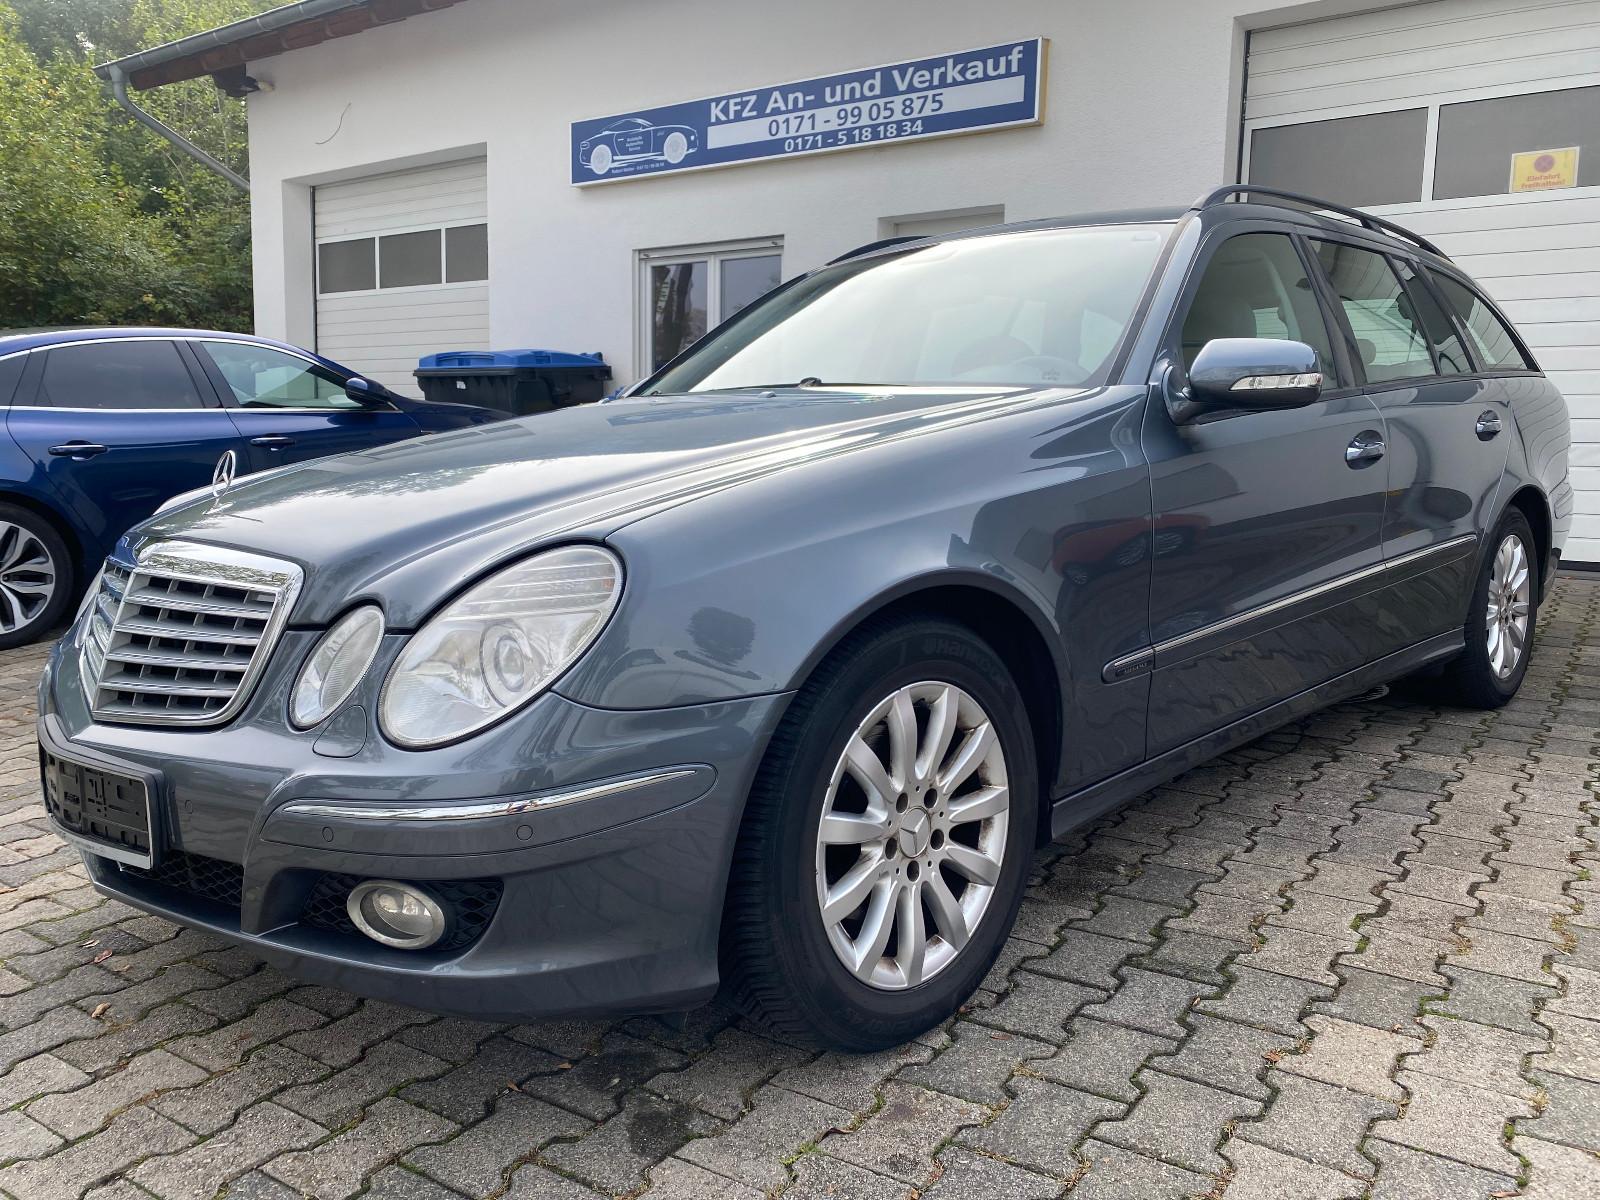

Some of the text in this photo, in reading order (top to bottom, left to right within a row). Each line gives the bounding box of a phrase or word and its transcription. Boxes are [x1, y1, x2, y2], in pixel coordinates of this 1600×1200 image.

[710, 45, 1024, 123] KFZ An- und Verkauf
[768, 112, 816, 137] 0171
[837, 106, 862, 127] 99
[868, 100, 895, 122] 05
[901, 92, 944, 117] 875
[784, 134, 822, 152] 0171
[837, 130, 847, 145] 5
[852, 127, 872, 143] 18
[876, 122, 897, 139] 18
[901, 119, 924, 136] 34
